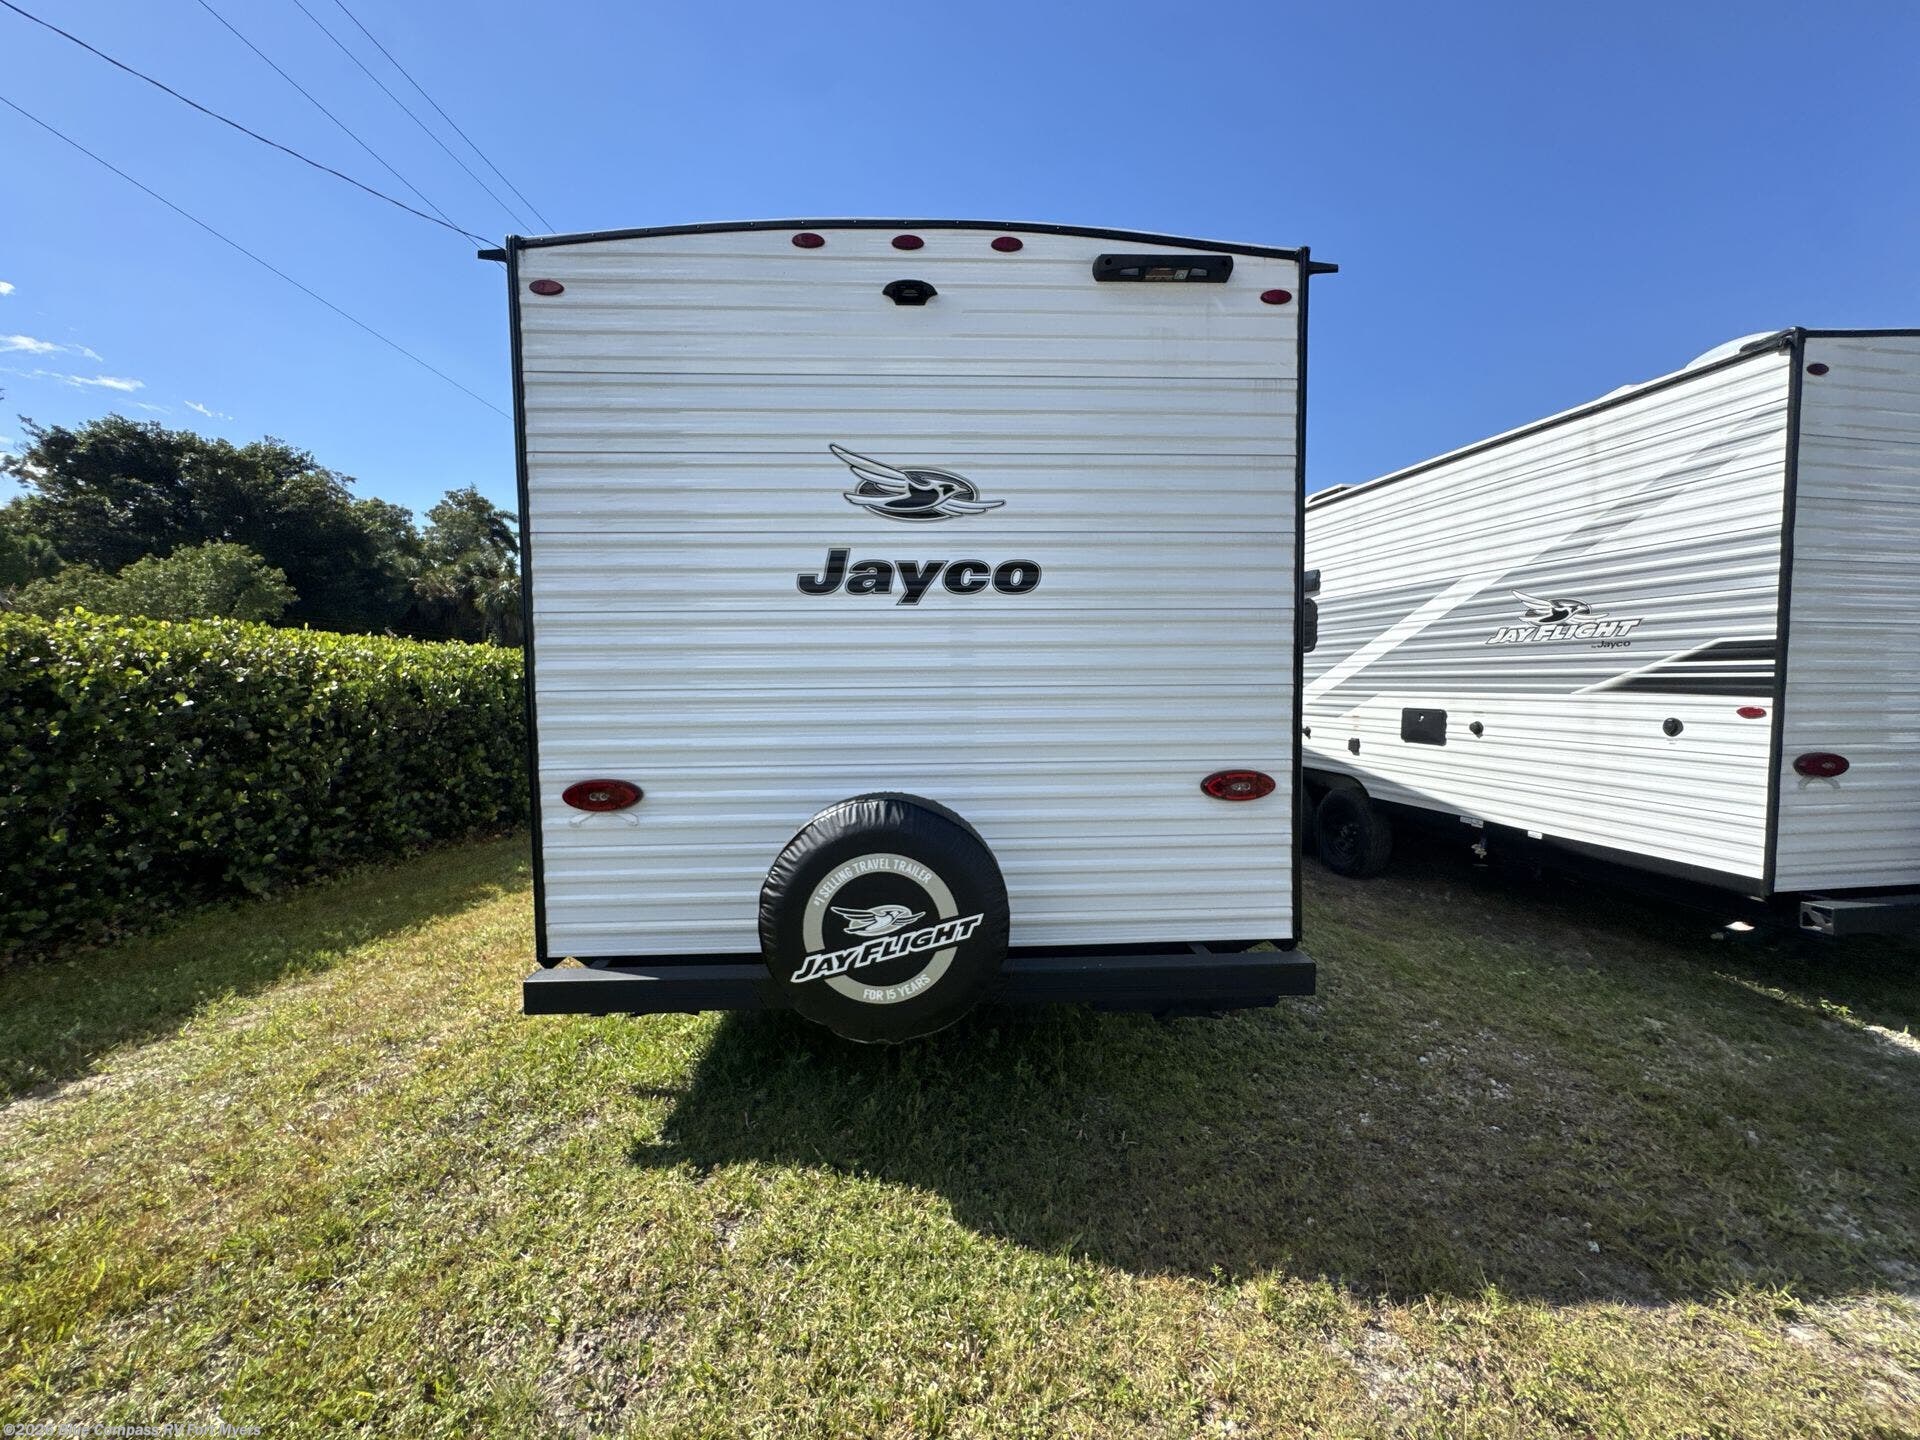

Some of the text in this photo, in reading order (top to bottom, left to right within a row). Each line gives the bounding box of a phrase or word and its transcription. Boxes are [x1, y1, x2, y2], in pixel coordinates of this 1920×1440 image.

[797, 548, 1042, 606] Jayco
[1598, 640, 1631, 649] Jayco
[819, 866, 854, 898] SELLING
[852, 858, 891, 874] TRAVEL
[893, 859, 933, 884] TRAILER
[863, 974, 931, 1000] FOR 15 YEARS
